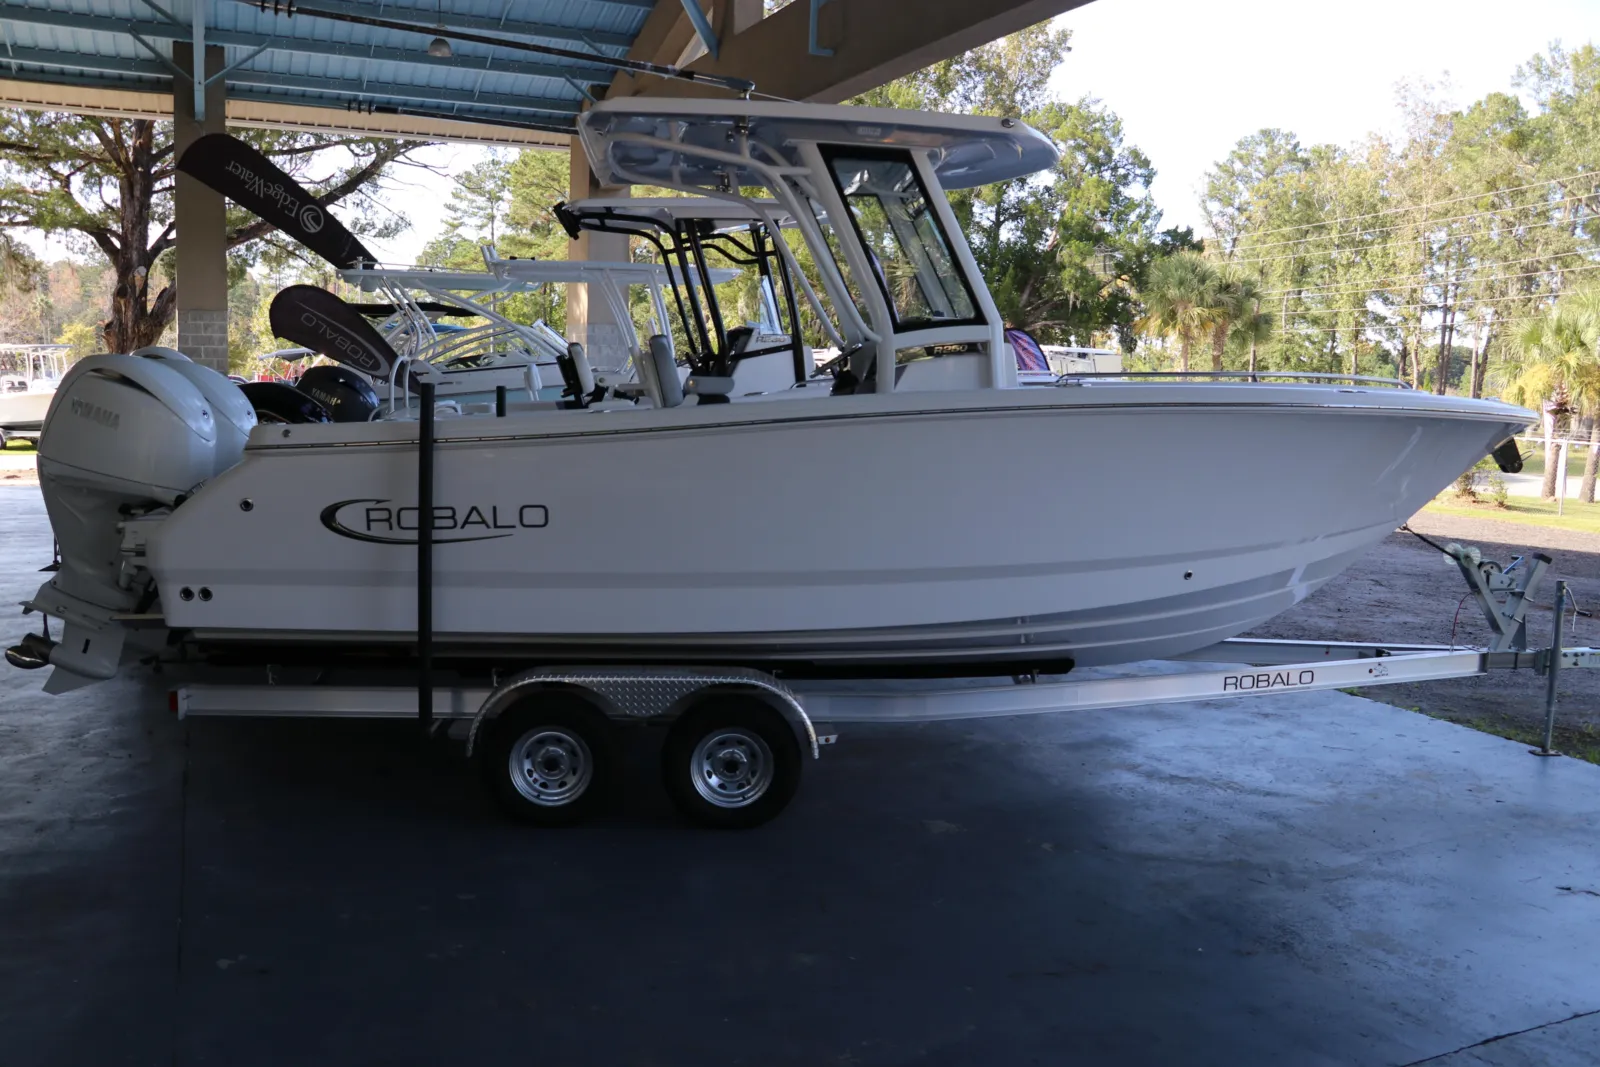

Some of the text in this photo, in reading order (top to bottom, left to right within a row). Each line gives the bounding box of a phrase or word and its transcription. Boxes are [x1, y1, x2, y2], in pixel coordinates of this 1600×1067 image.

[225, 159, 300, 217] EdgeWater
[301, 312, 374, 368] ROBALO
[311, 387, 341, 406] YAMAHA
[71, 397, 120, 431] YAMAHA
[365, 504, 549, 531] ROBALO
[1223, 670, 1315, 691] ROBALO
